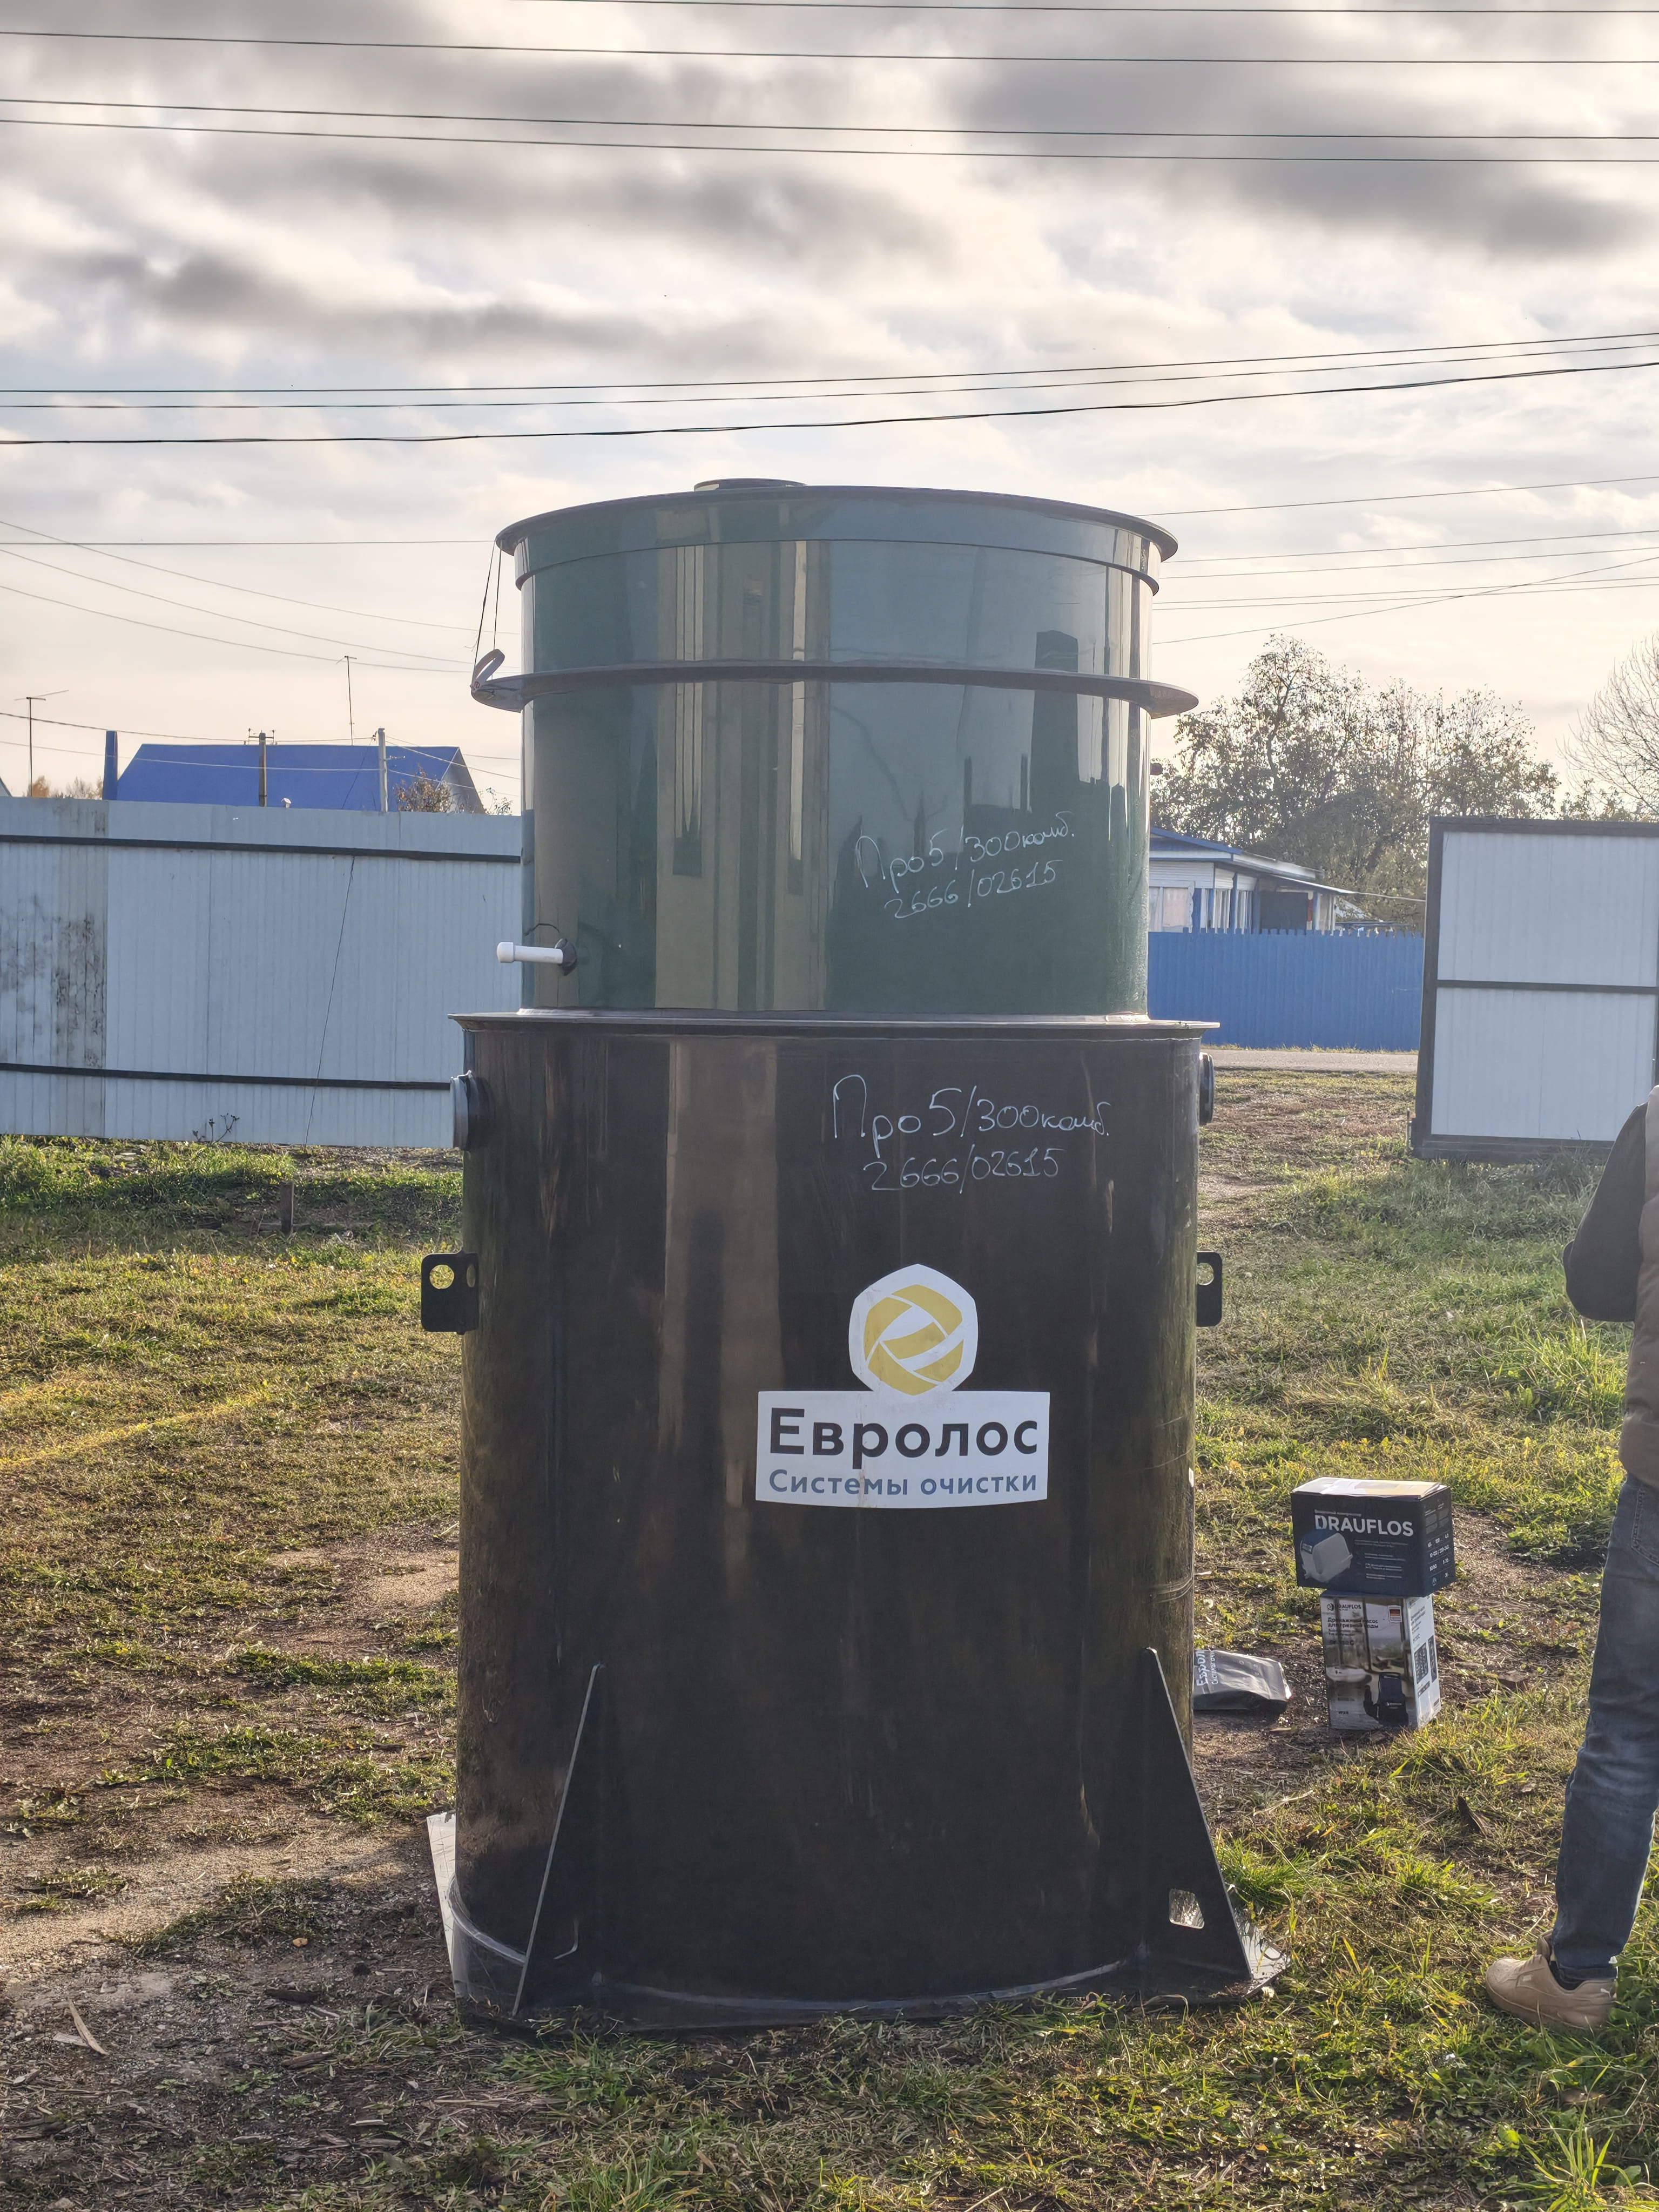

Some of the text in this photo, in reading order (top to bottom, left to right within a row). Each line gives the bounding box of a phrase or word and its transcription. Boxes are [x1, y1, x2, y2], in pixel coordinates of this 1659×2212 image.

[770, 1407, 1038, 1469] Евролос
[769, 1469, 1036, 1495] Системы очистки
[1314, 1515, 1414, 1537] DRAUFLOS
